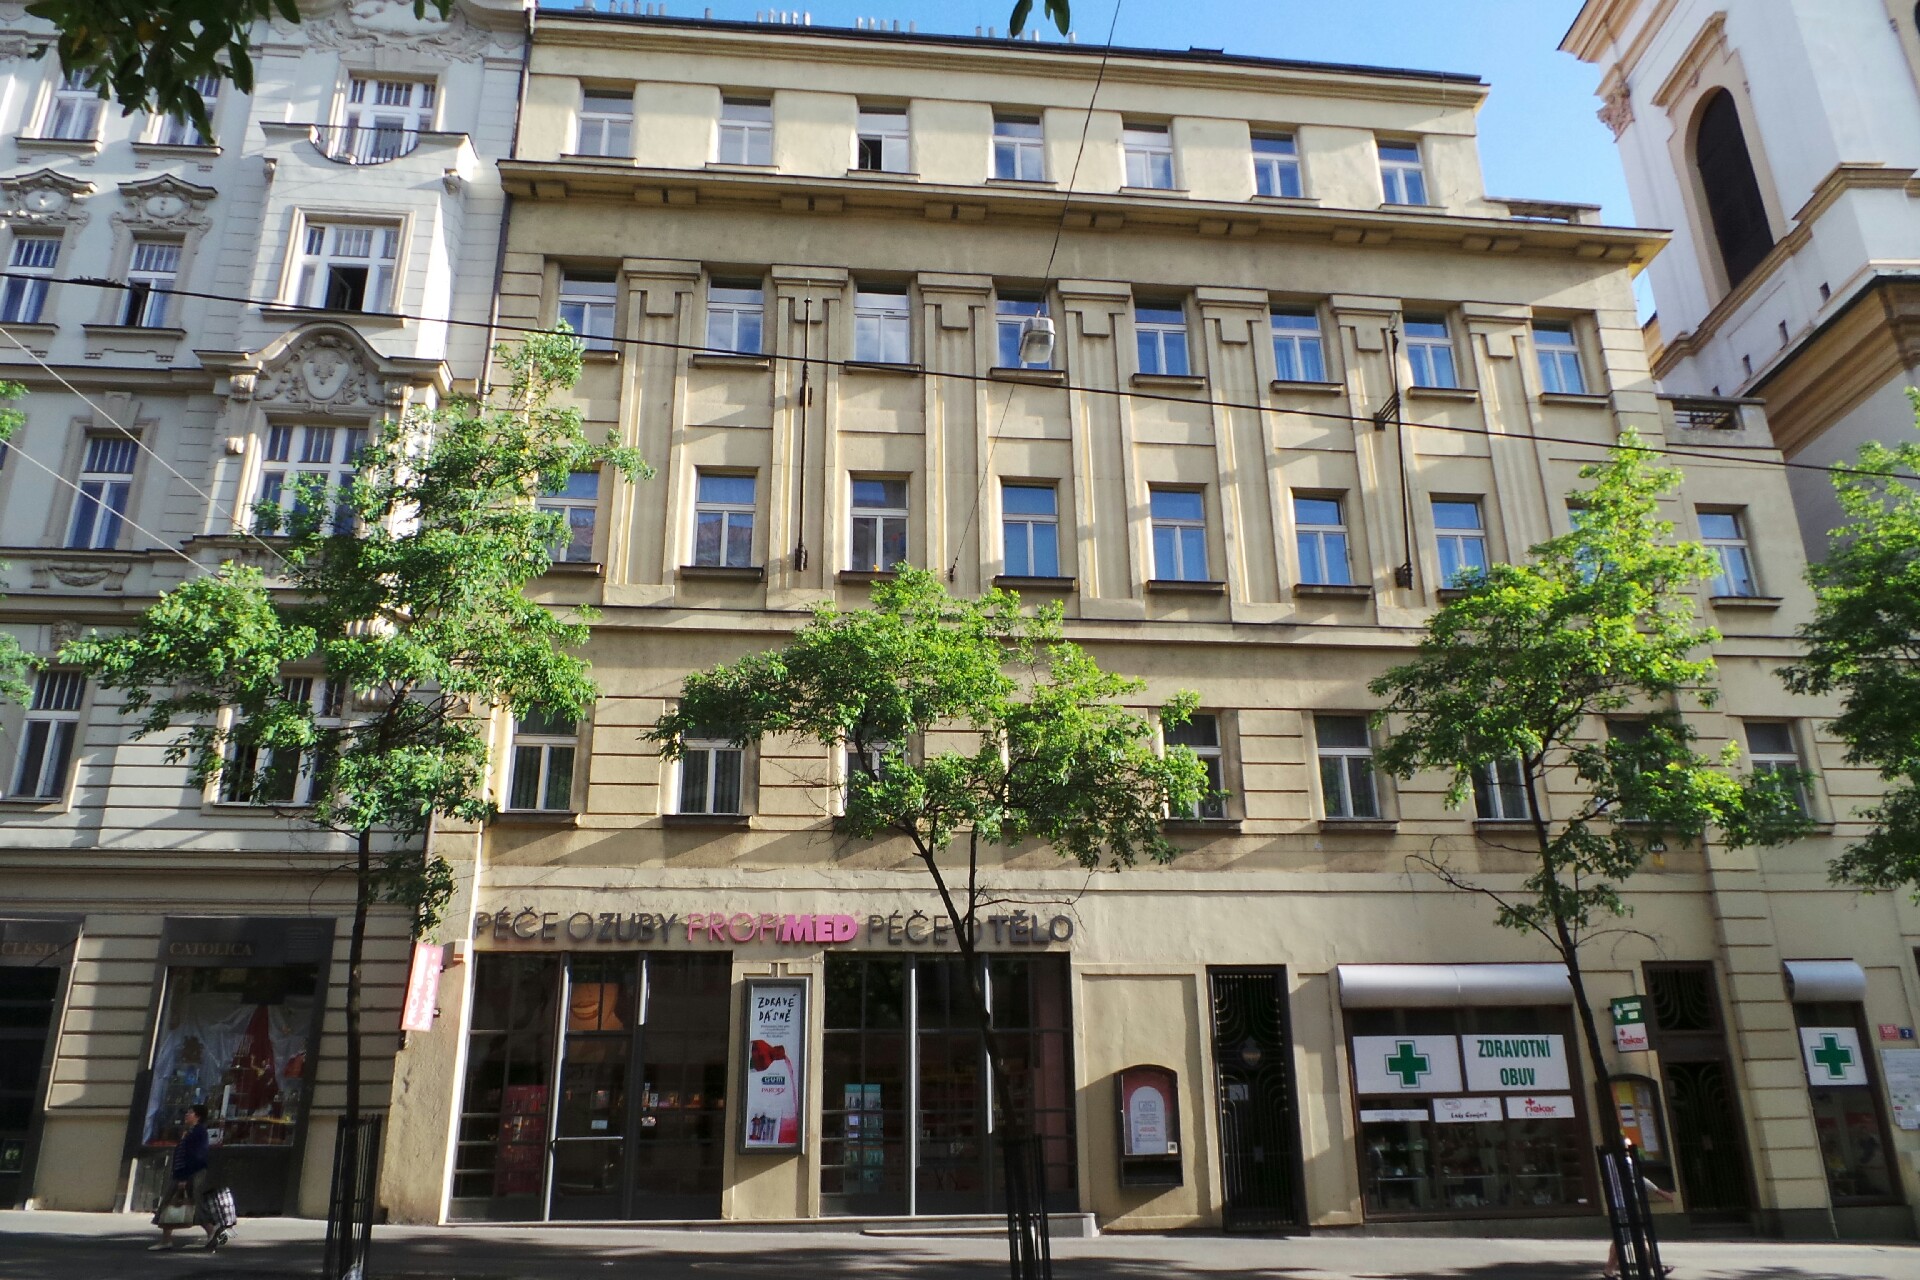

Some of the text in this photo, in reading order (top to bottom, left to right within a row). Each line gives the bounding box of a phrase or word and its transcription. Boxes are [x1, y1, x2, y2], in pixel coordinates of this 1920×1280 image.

[473, 906, 560, 944] PÉČE
[686, 911, 859, 944] PROFIMED
[866, 909, 949, 945] PÉČE
[987, 909, 1074, 945] TĚLO
[169, 942, 253, 956] CATOLICA
[757, 993, 798, 1009] ZDRAVÉ
[758, 1009, 792, 1023] DÁSNĚ
[1477, 1035, 1551, 1058] ZDRAVOTNÍ
[1500, 1067, 1535, 1086] OBUV
